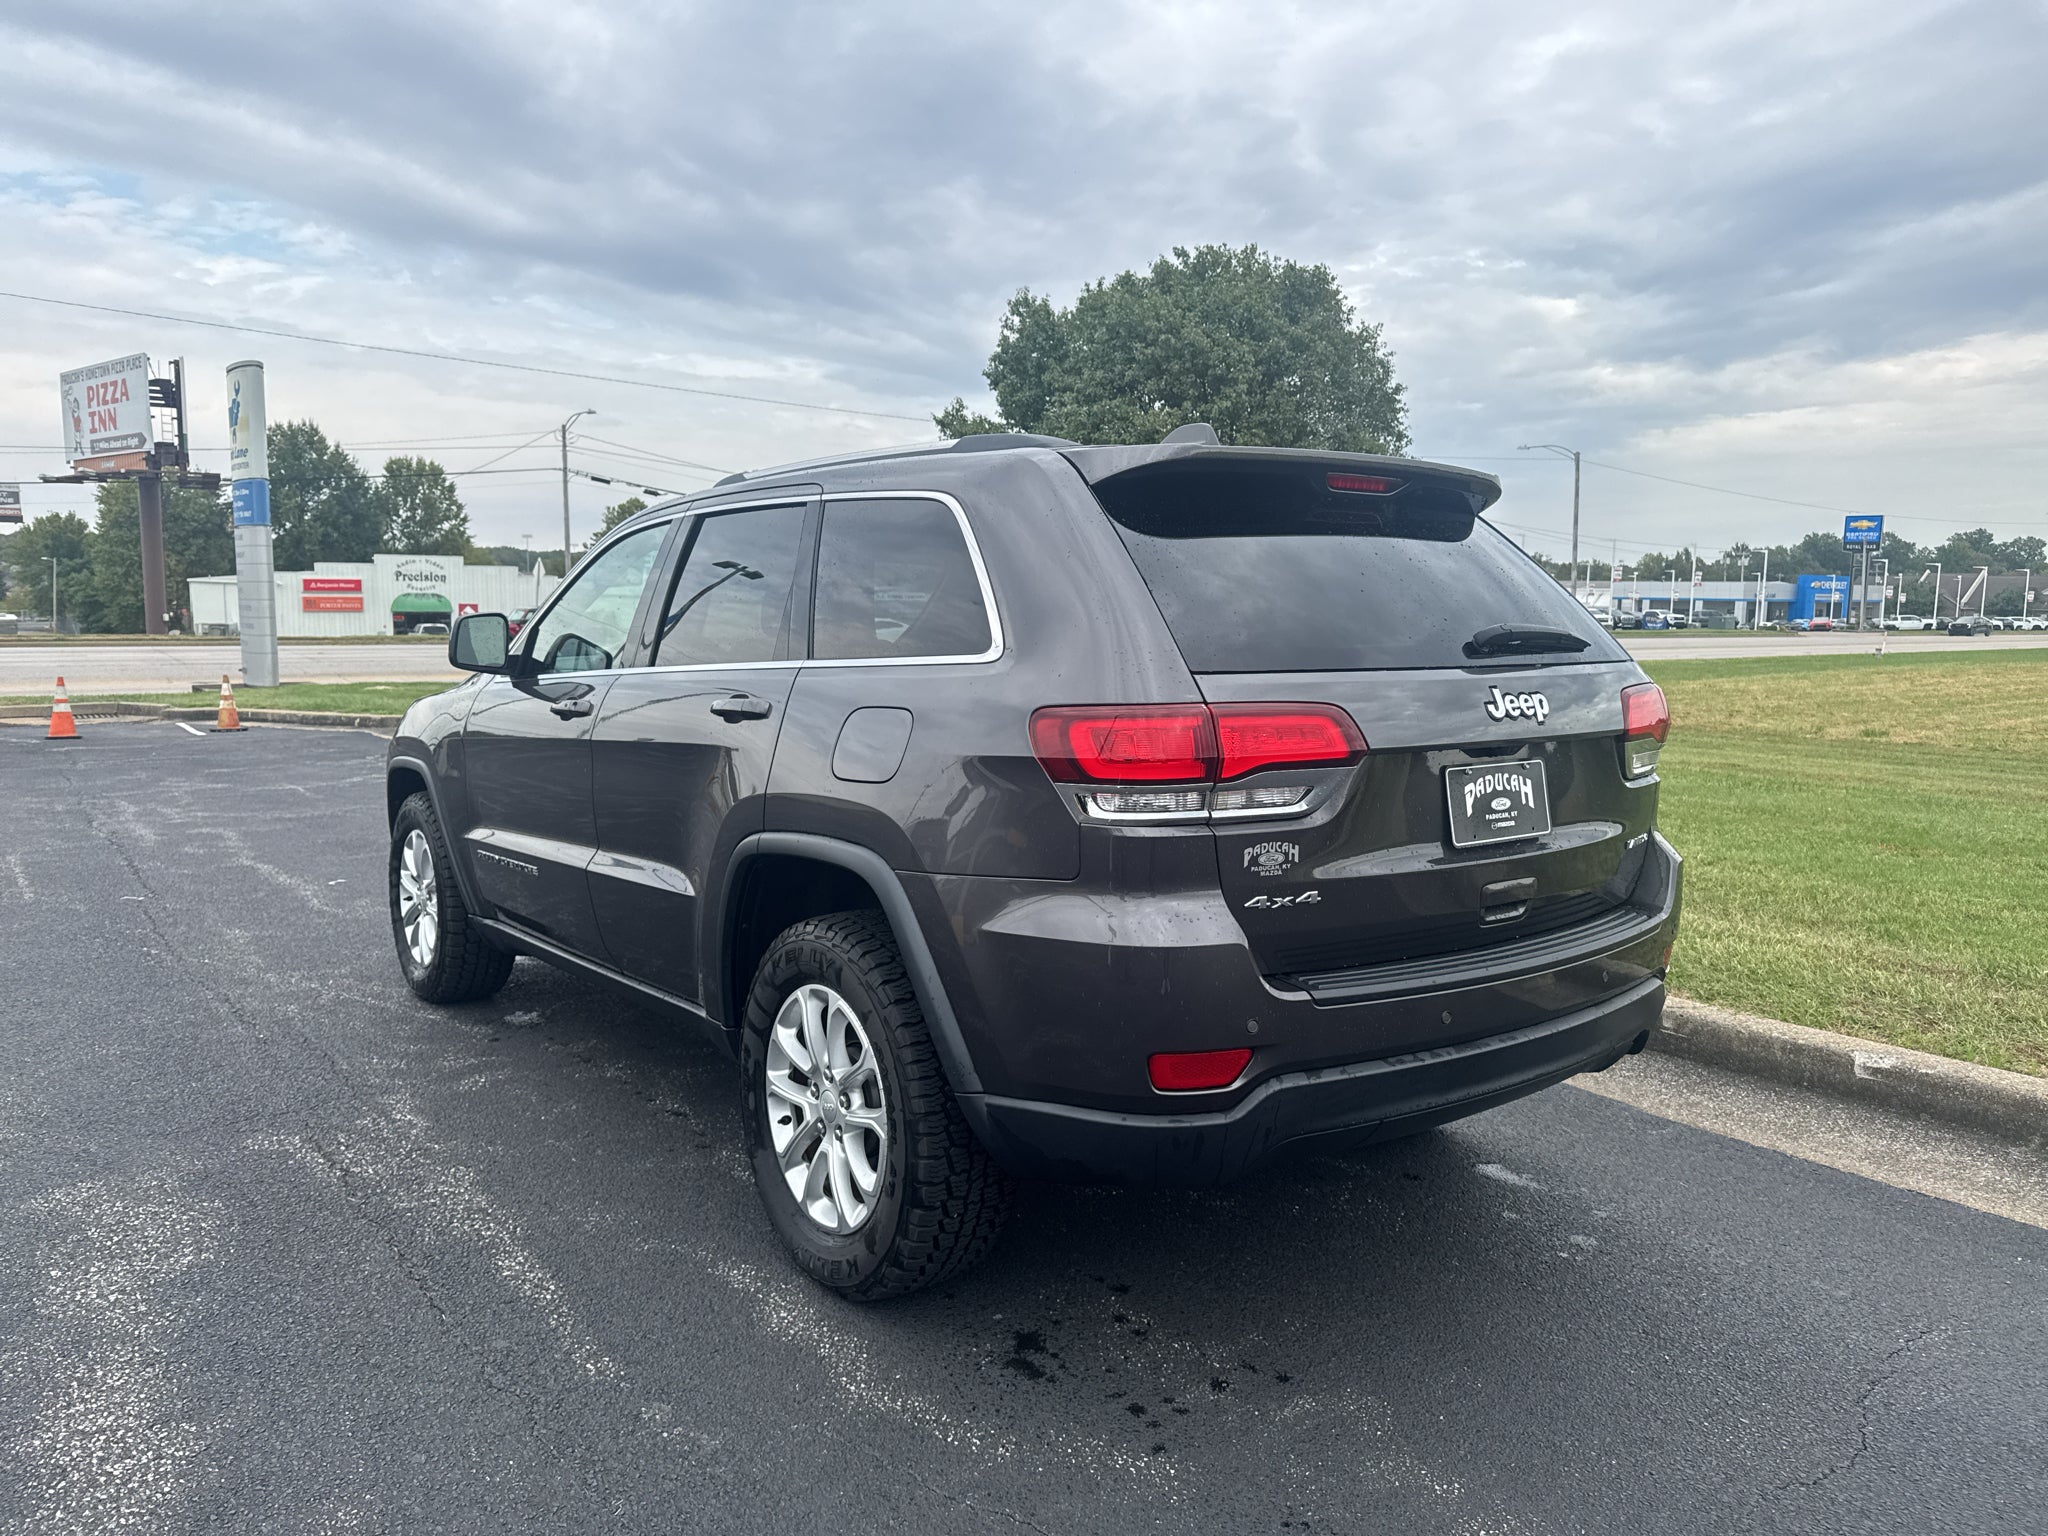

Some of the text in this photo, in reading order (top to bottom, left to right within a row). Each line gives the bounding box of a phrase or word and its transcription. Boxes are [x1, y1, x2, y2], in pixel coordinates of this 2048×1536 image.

[111, 361, 125, 375] PIZZA
[126, 356, 142, 371] PLACE
[86, 378, 129, 409] PIZZA
[88, 407, 118, 434] INN
[395, 570, 447, 584] Precision
[396, 559, 444, 571] Audio Video
[406, 583, 436, 592] Security
[1486, 686, 1549, 723] Jeep
[1464, 773, 1535, 818] PADUCAH
[1244, 841, 1299, 868] PADUCAH
[1244, 890, 1321, 909] 4x4
[771, 946, 835, 977] KELLY
